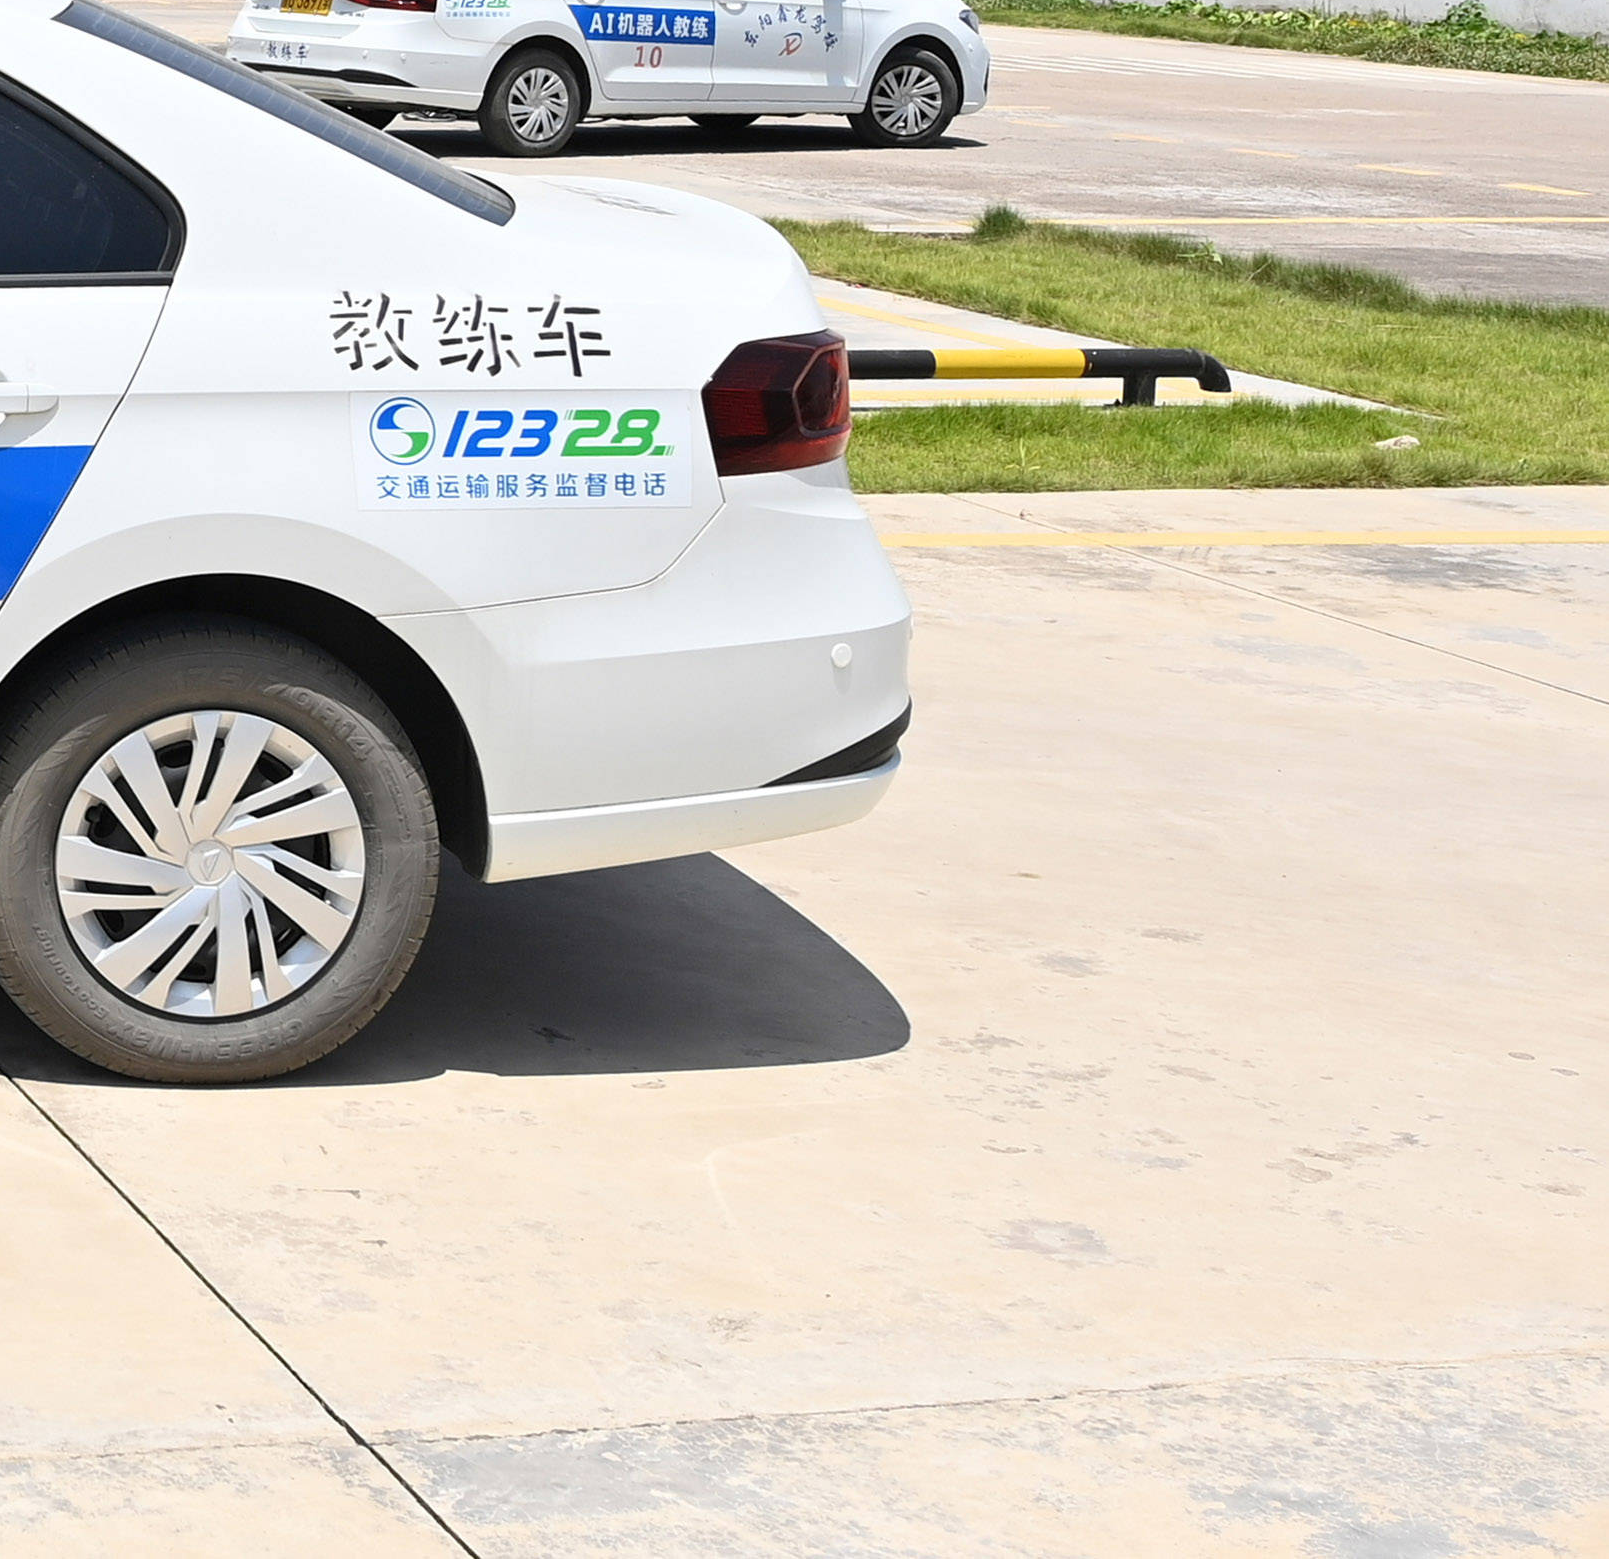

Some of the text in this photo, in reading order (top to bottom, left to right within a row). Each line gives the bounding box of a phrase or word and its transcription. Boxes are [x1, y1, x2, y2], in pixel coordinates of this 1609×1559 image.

[589, 12, 709, 39] AI机器人教练
[634, 46, 662, 68] 10
[330, 291, 611, 377] 教练车
[442, 409, 670, 457] 12328
[376, 473, 667, 500] 交通运输服务监督电话
